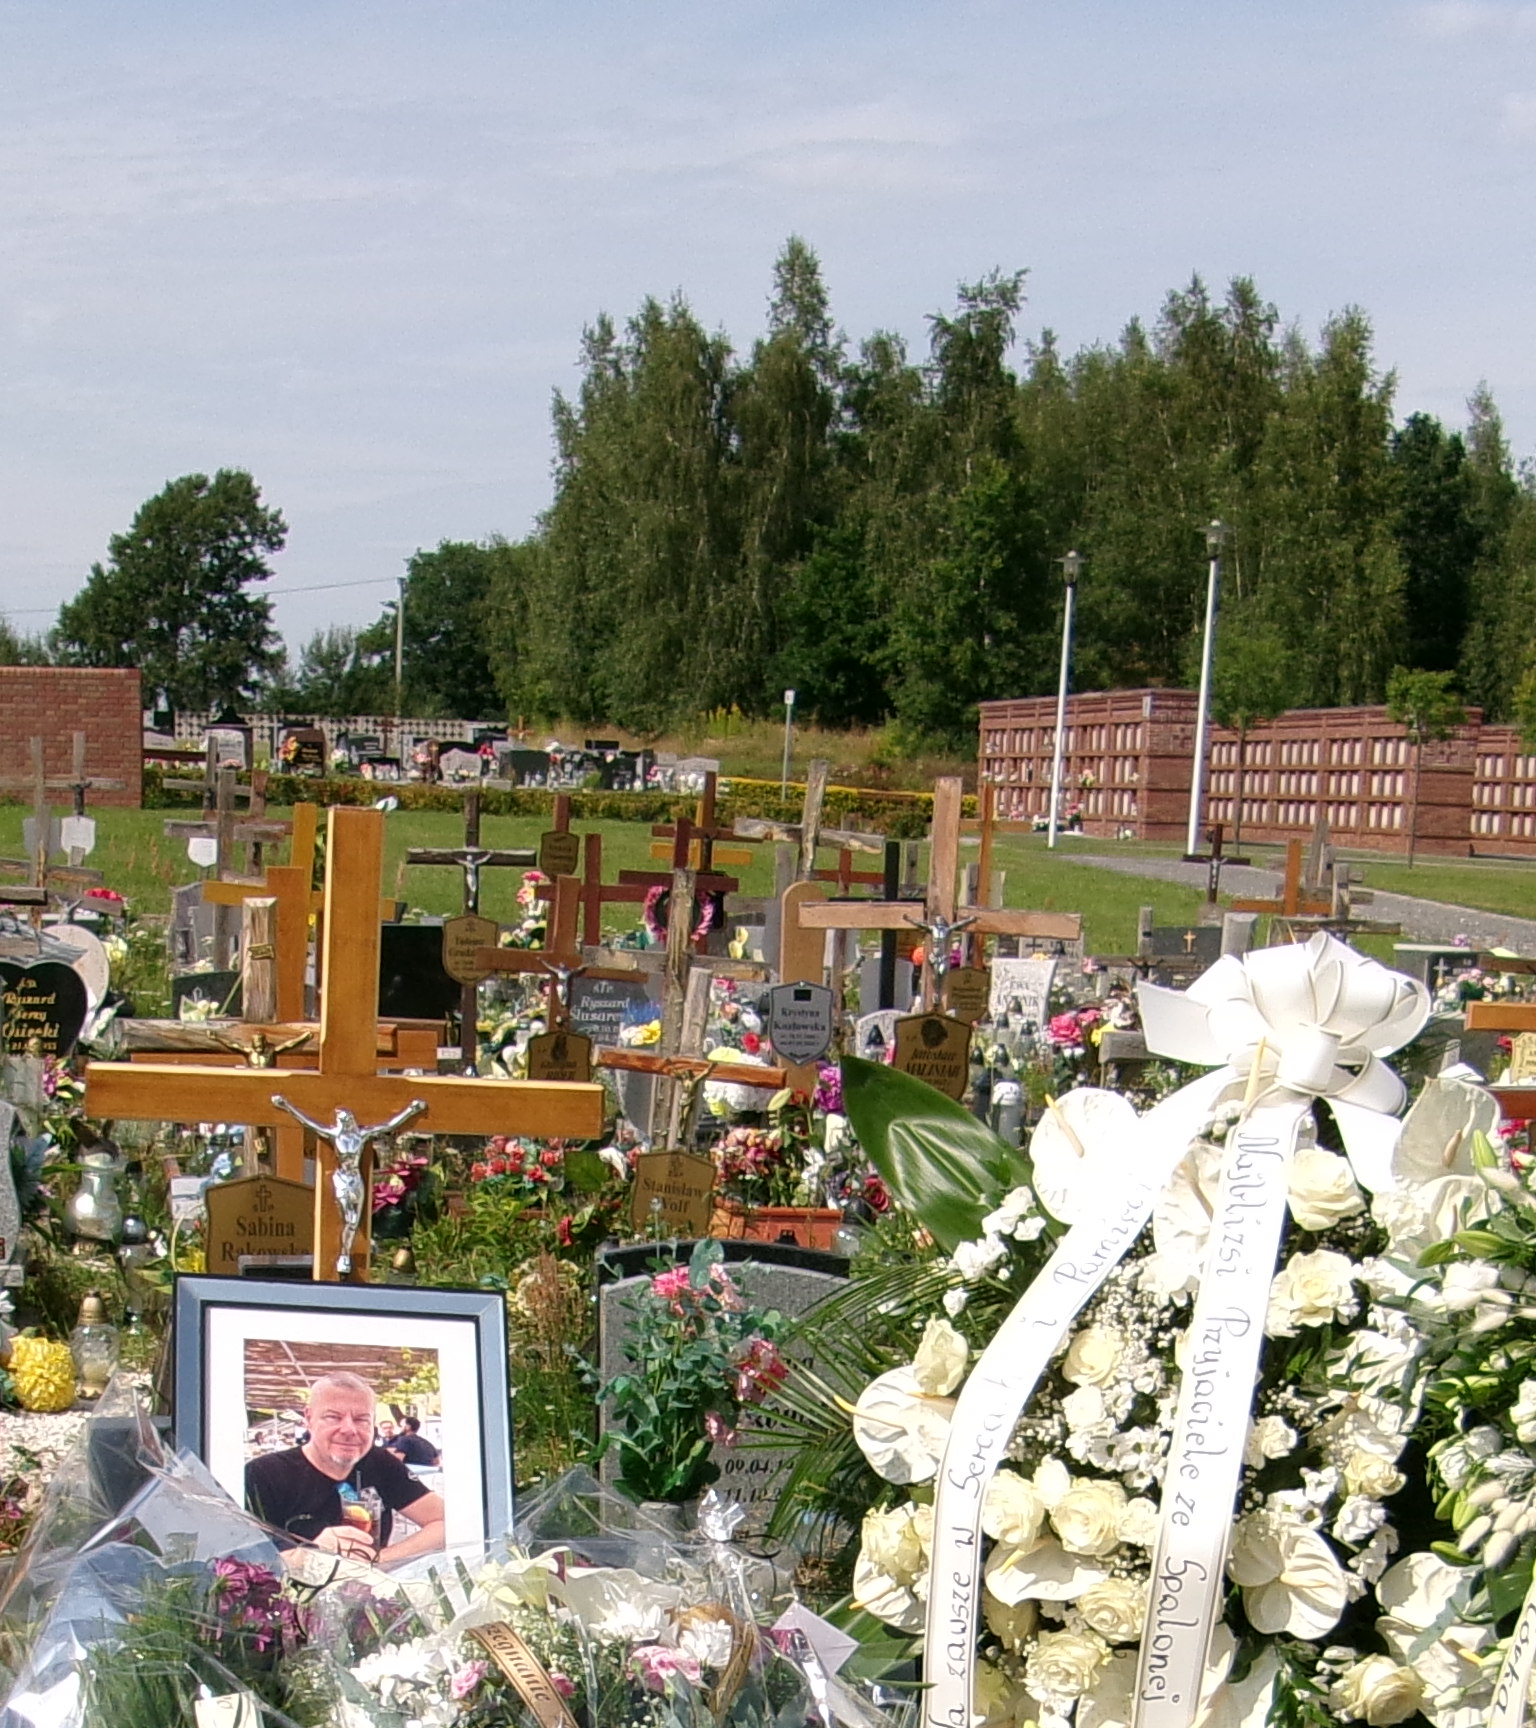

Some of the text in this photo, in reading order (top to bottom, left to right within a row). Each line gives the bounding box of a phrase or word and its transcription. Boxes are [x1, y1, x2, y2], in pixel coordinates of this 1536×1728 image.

[236, 1216, 295, 1237] Sabina
[949, 1376, 1013, 1499] Sercah
[1179, 1306, 1251, 1480] Przyjaciele
[954, 1526, 974, 1548] w
[1171, 1491, 1196, 1527] ze
[947, 1571, 971, 1679] zawsze
[1141, 1555, 1208, 1703] Spalonej
